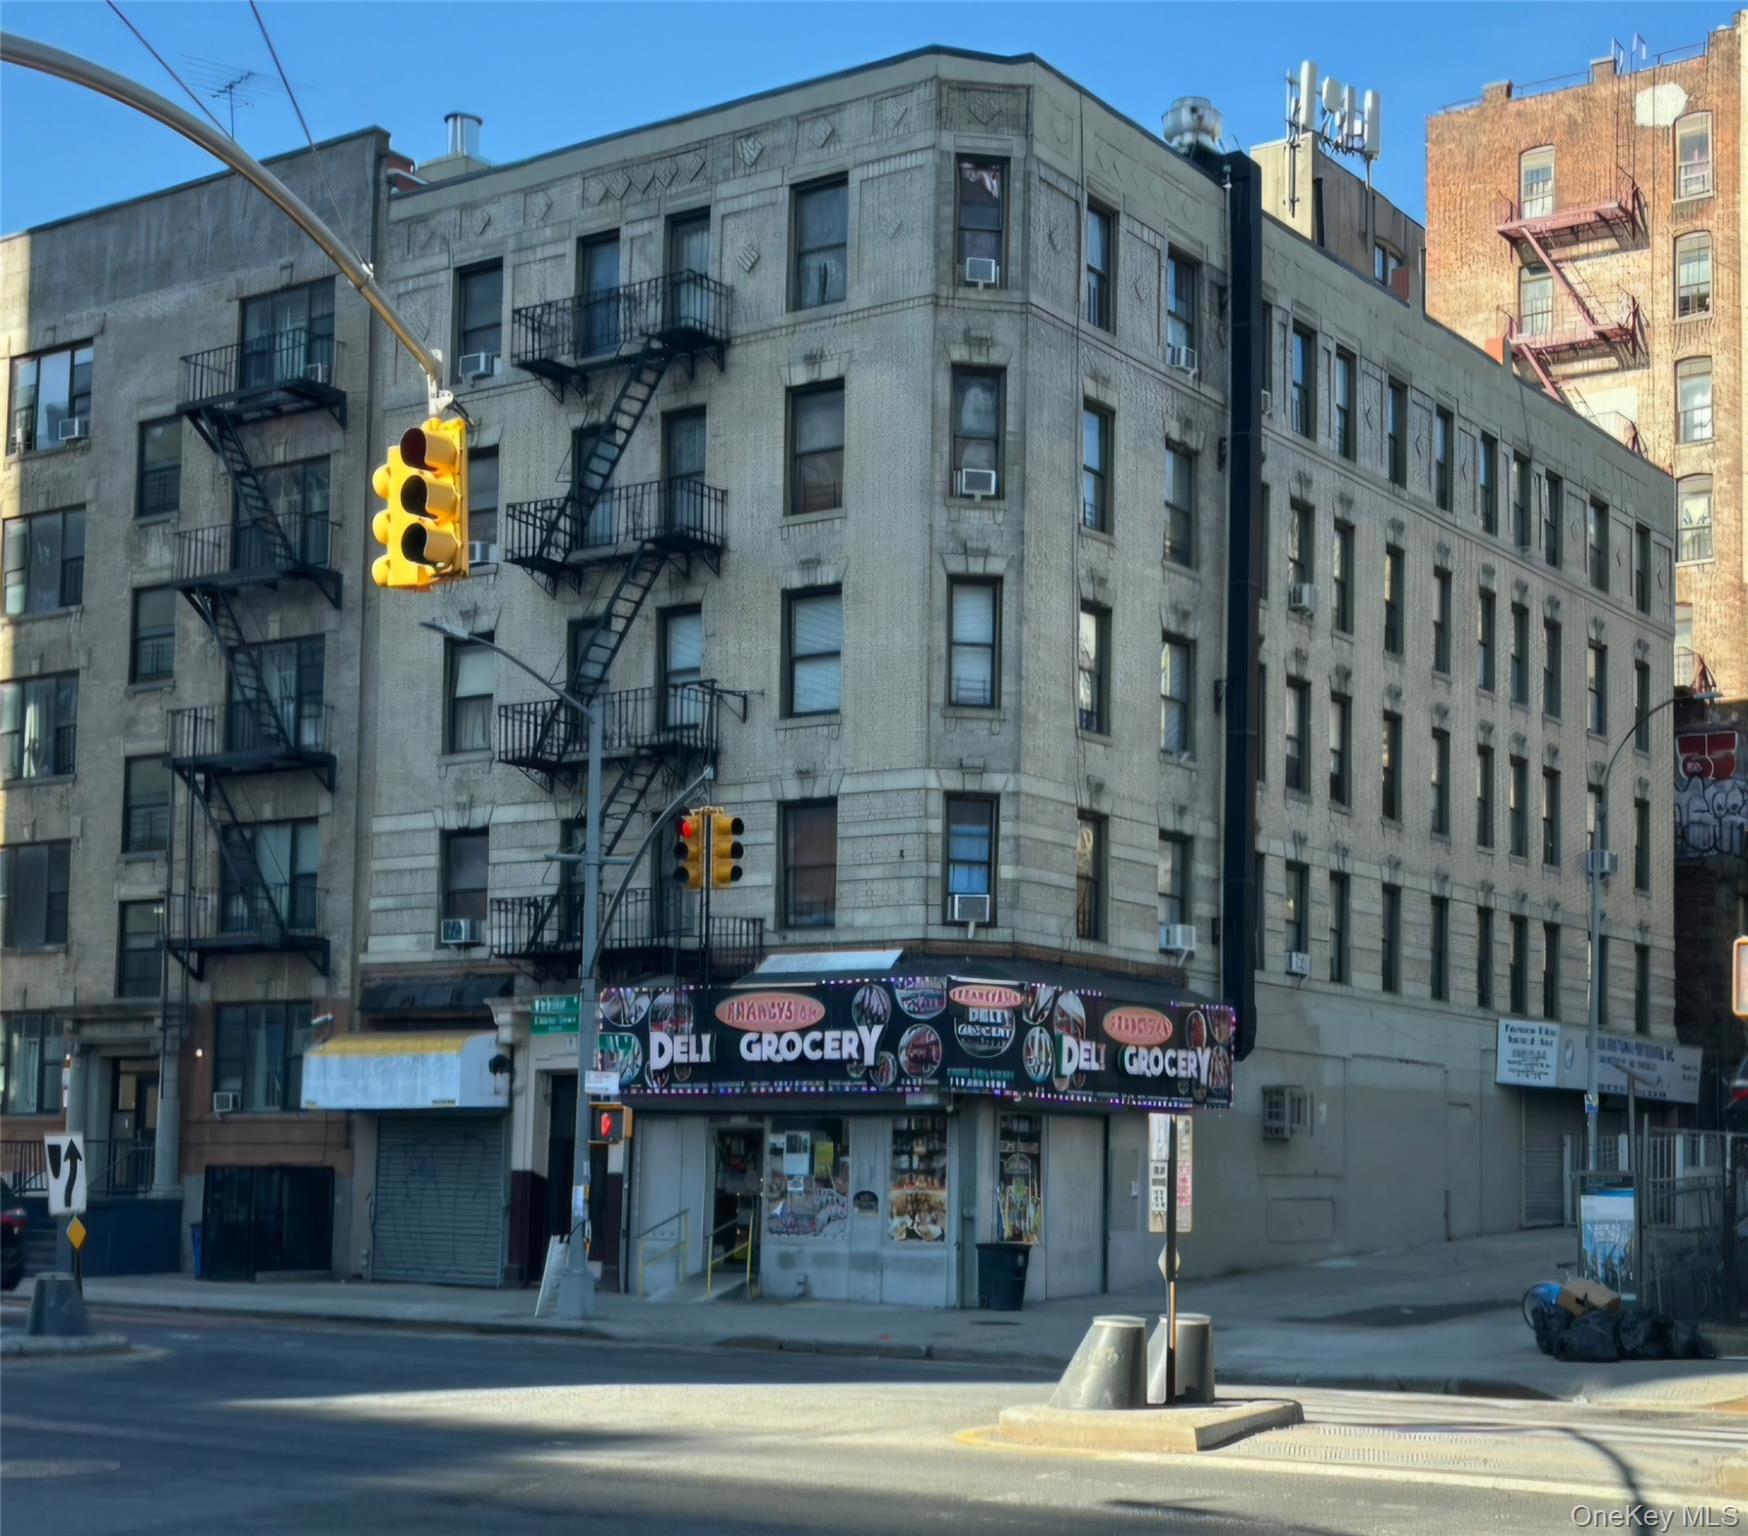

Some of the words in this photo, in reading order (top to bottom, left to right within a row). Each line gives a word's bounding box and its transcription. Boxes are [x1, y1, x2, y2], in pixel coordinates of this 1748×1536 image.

[649, 1031, 711, 1071] DELI
[739, 1024, 885, 1067] GROCERY
[1060, 1034, 1106, 1076] DELI
[1123, 1045, 1211, 1085] GROCERY
